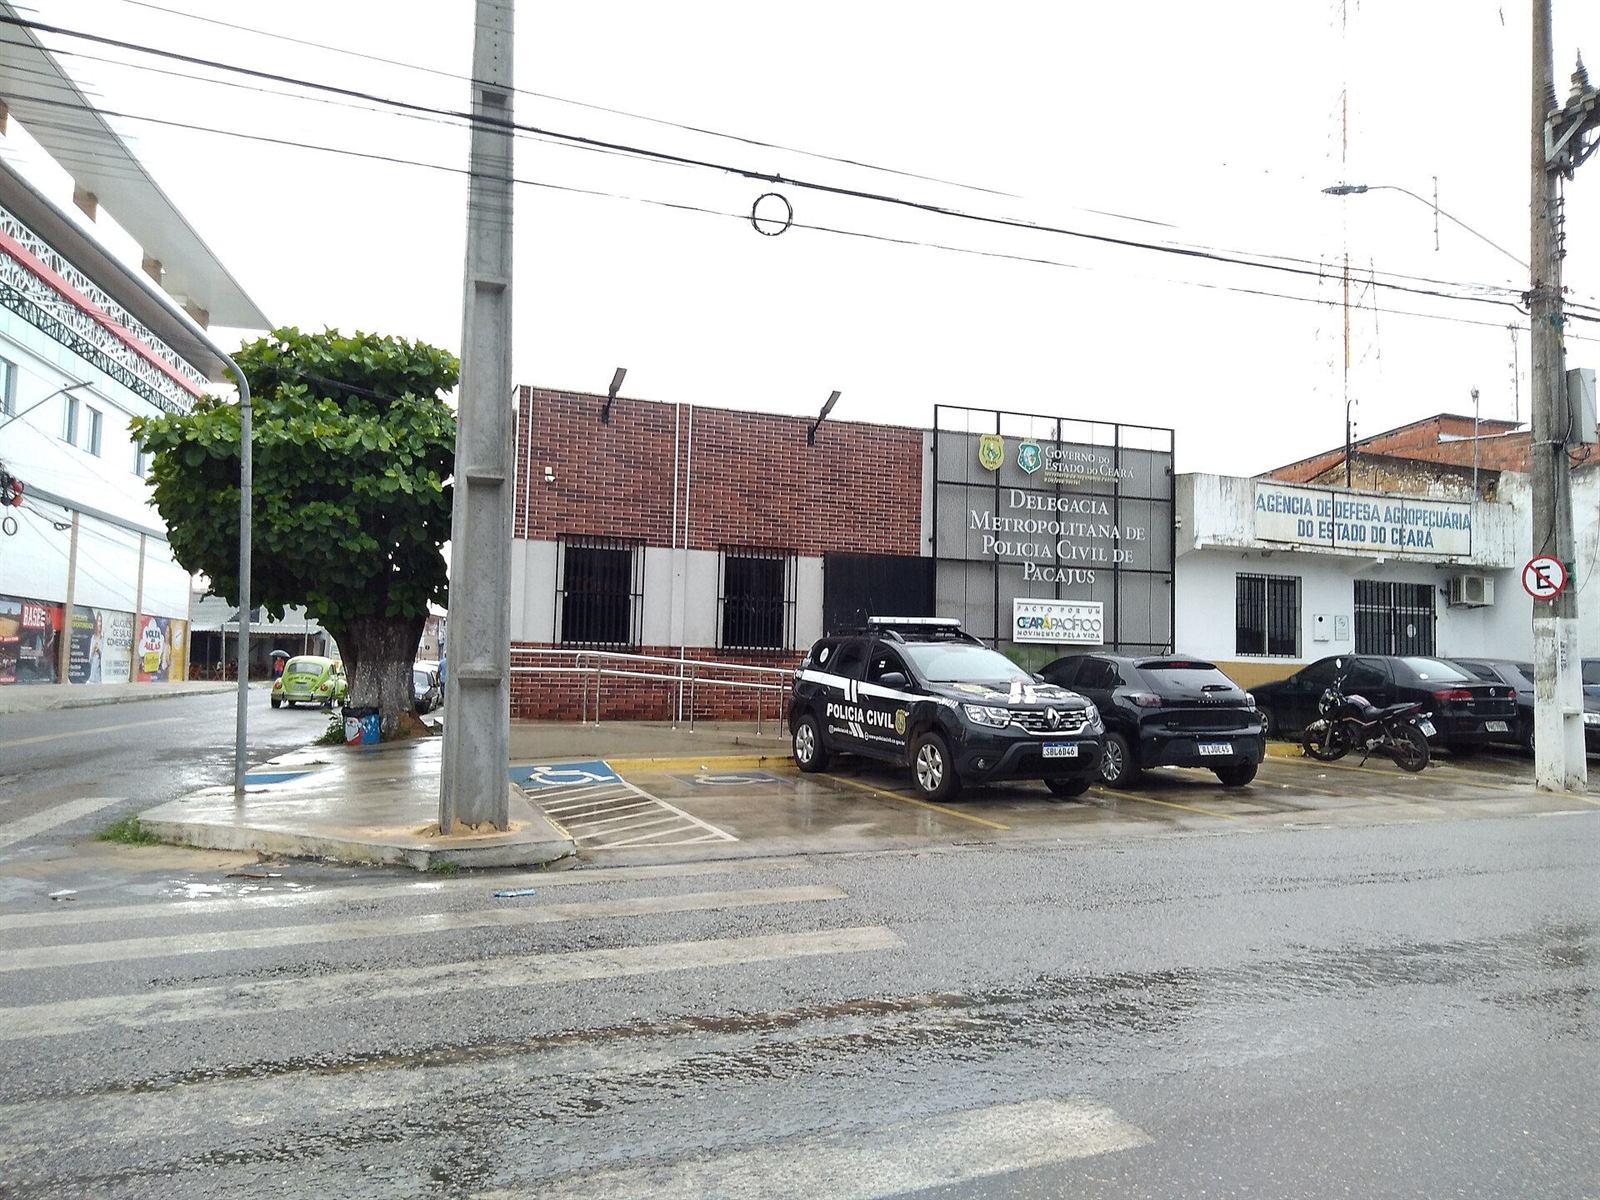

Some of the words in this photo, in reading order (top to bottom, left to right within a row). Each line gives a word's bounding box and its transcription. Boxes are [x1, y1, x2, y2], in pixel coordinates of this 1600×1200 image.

[1045, 446, 1095, 463] GOVERNO
[1045, 460, 1085, 474] ESTADO
[1099, 463, 1134, 479] CEARÁ
[1009, 489, 1109, 515] DELEGACIA
[1256, 491, 1313, 517] AGÊNCIA
[1316, 499, 1332, 518] DE
[1335, 501, 1381, 523] DEFESA
[1384, 505, 1472, 531] AGROPECUÁRIA
[969, 510, 1121, 540] METROPOLITANA
[1126, 527, 1146, 541] DE
[1297, 519, 1314, 538] DO
[1319, 522, 1366, 542] ESTADO
[1371, 527, 1387, 545] DO
[1391, 527, 1434, 549] CEARÁ
[982, 534, 1053, 559] POLICIA
[1057, 540, 1108, 562] CIVIL
[1113, 549, 1134, 564] DE
[1023, 561, 1095, 586] PACAJUS
[1536, 565, 1551, 590] E
[1017, 605, 1053, 613] PACTO
[827, 702, 865, 724] POLICIA
[866, 709, 895, 729] CIVIL
